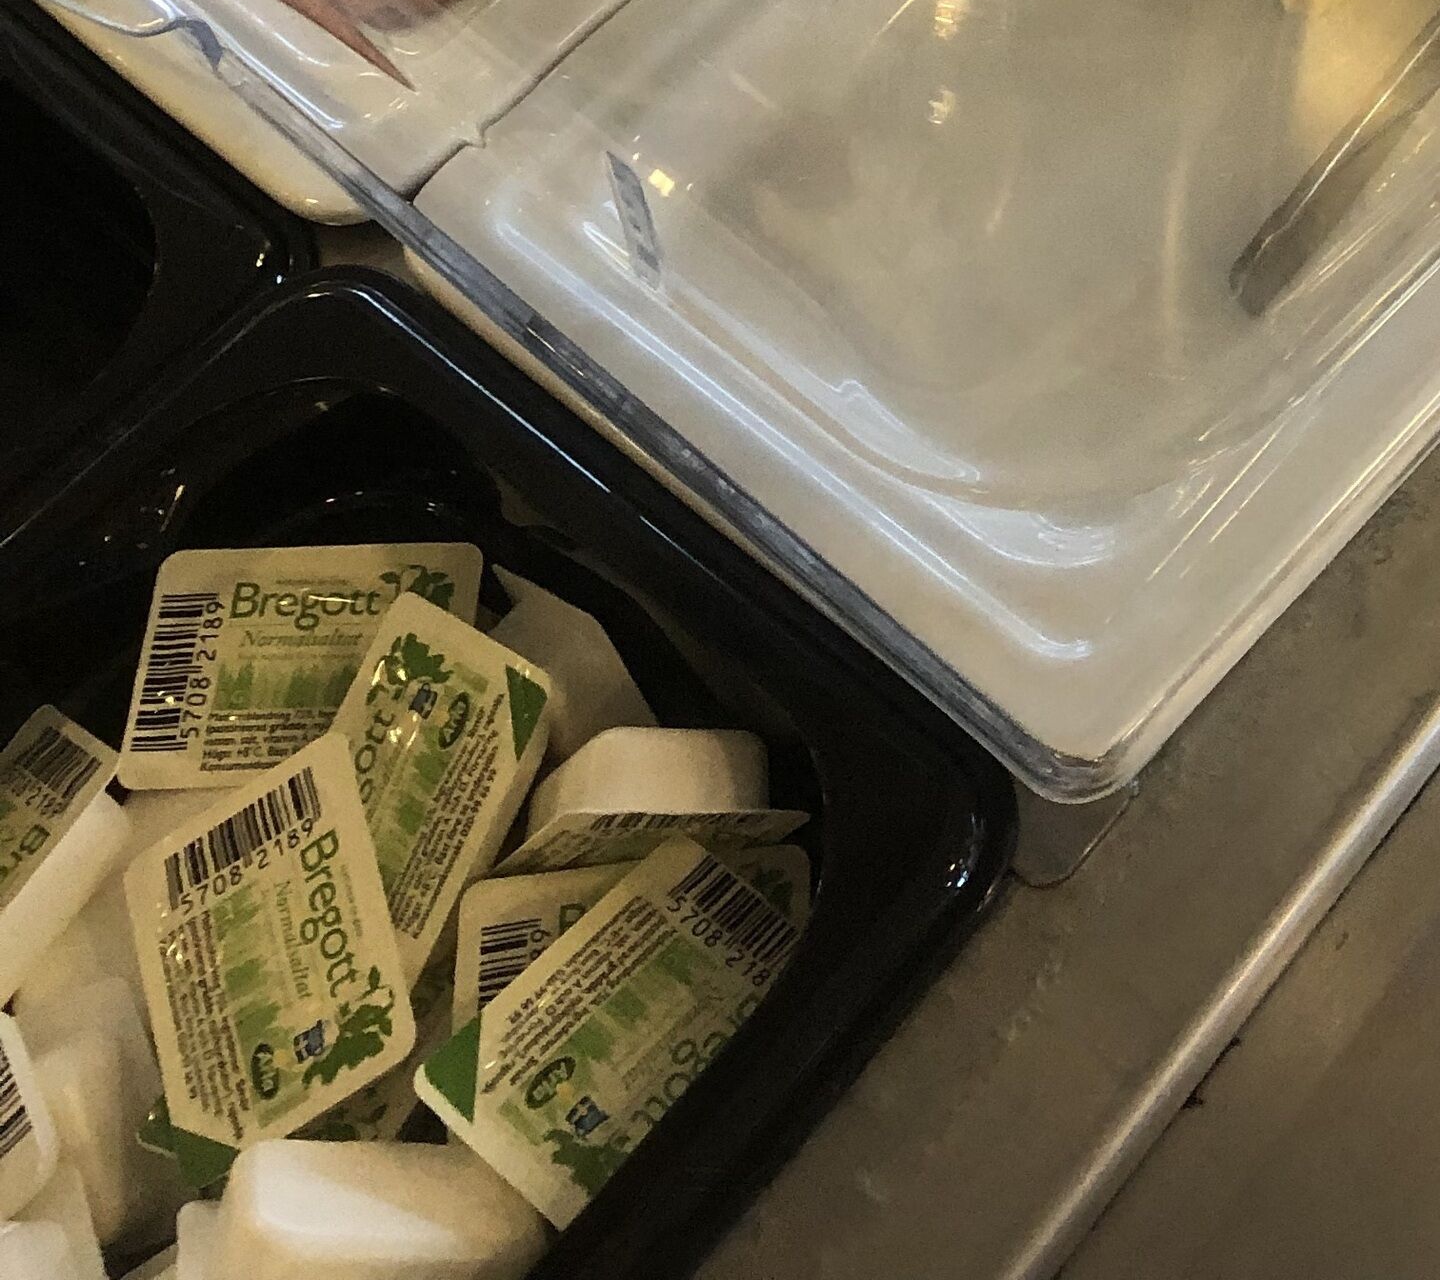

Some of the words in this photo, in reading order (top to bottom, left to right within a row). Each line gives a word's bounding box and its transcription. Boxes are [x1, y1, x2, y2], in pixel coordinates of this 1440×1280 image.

[229, 581, 382, 630] Bregott
[179, 676, 211, 739] 5708
[196, 601, 226, 662] 2189
[180, 867, 242, 914] 5708
[257, 817, 314, 870] 2189
[299, 829, 360, 999] Bregott
[666, 895, 724, 947] 5708
[724, 948, 772, 989] 218
